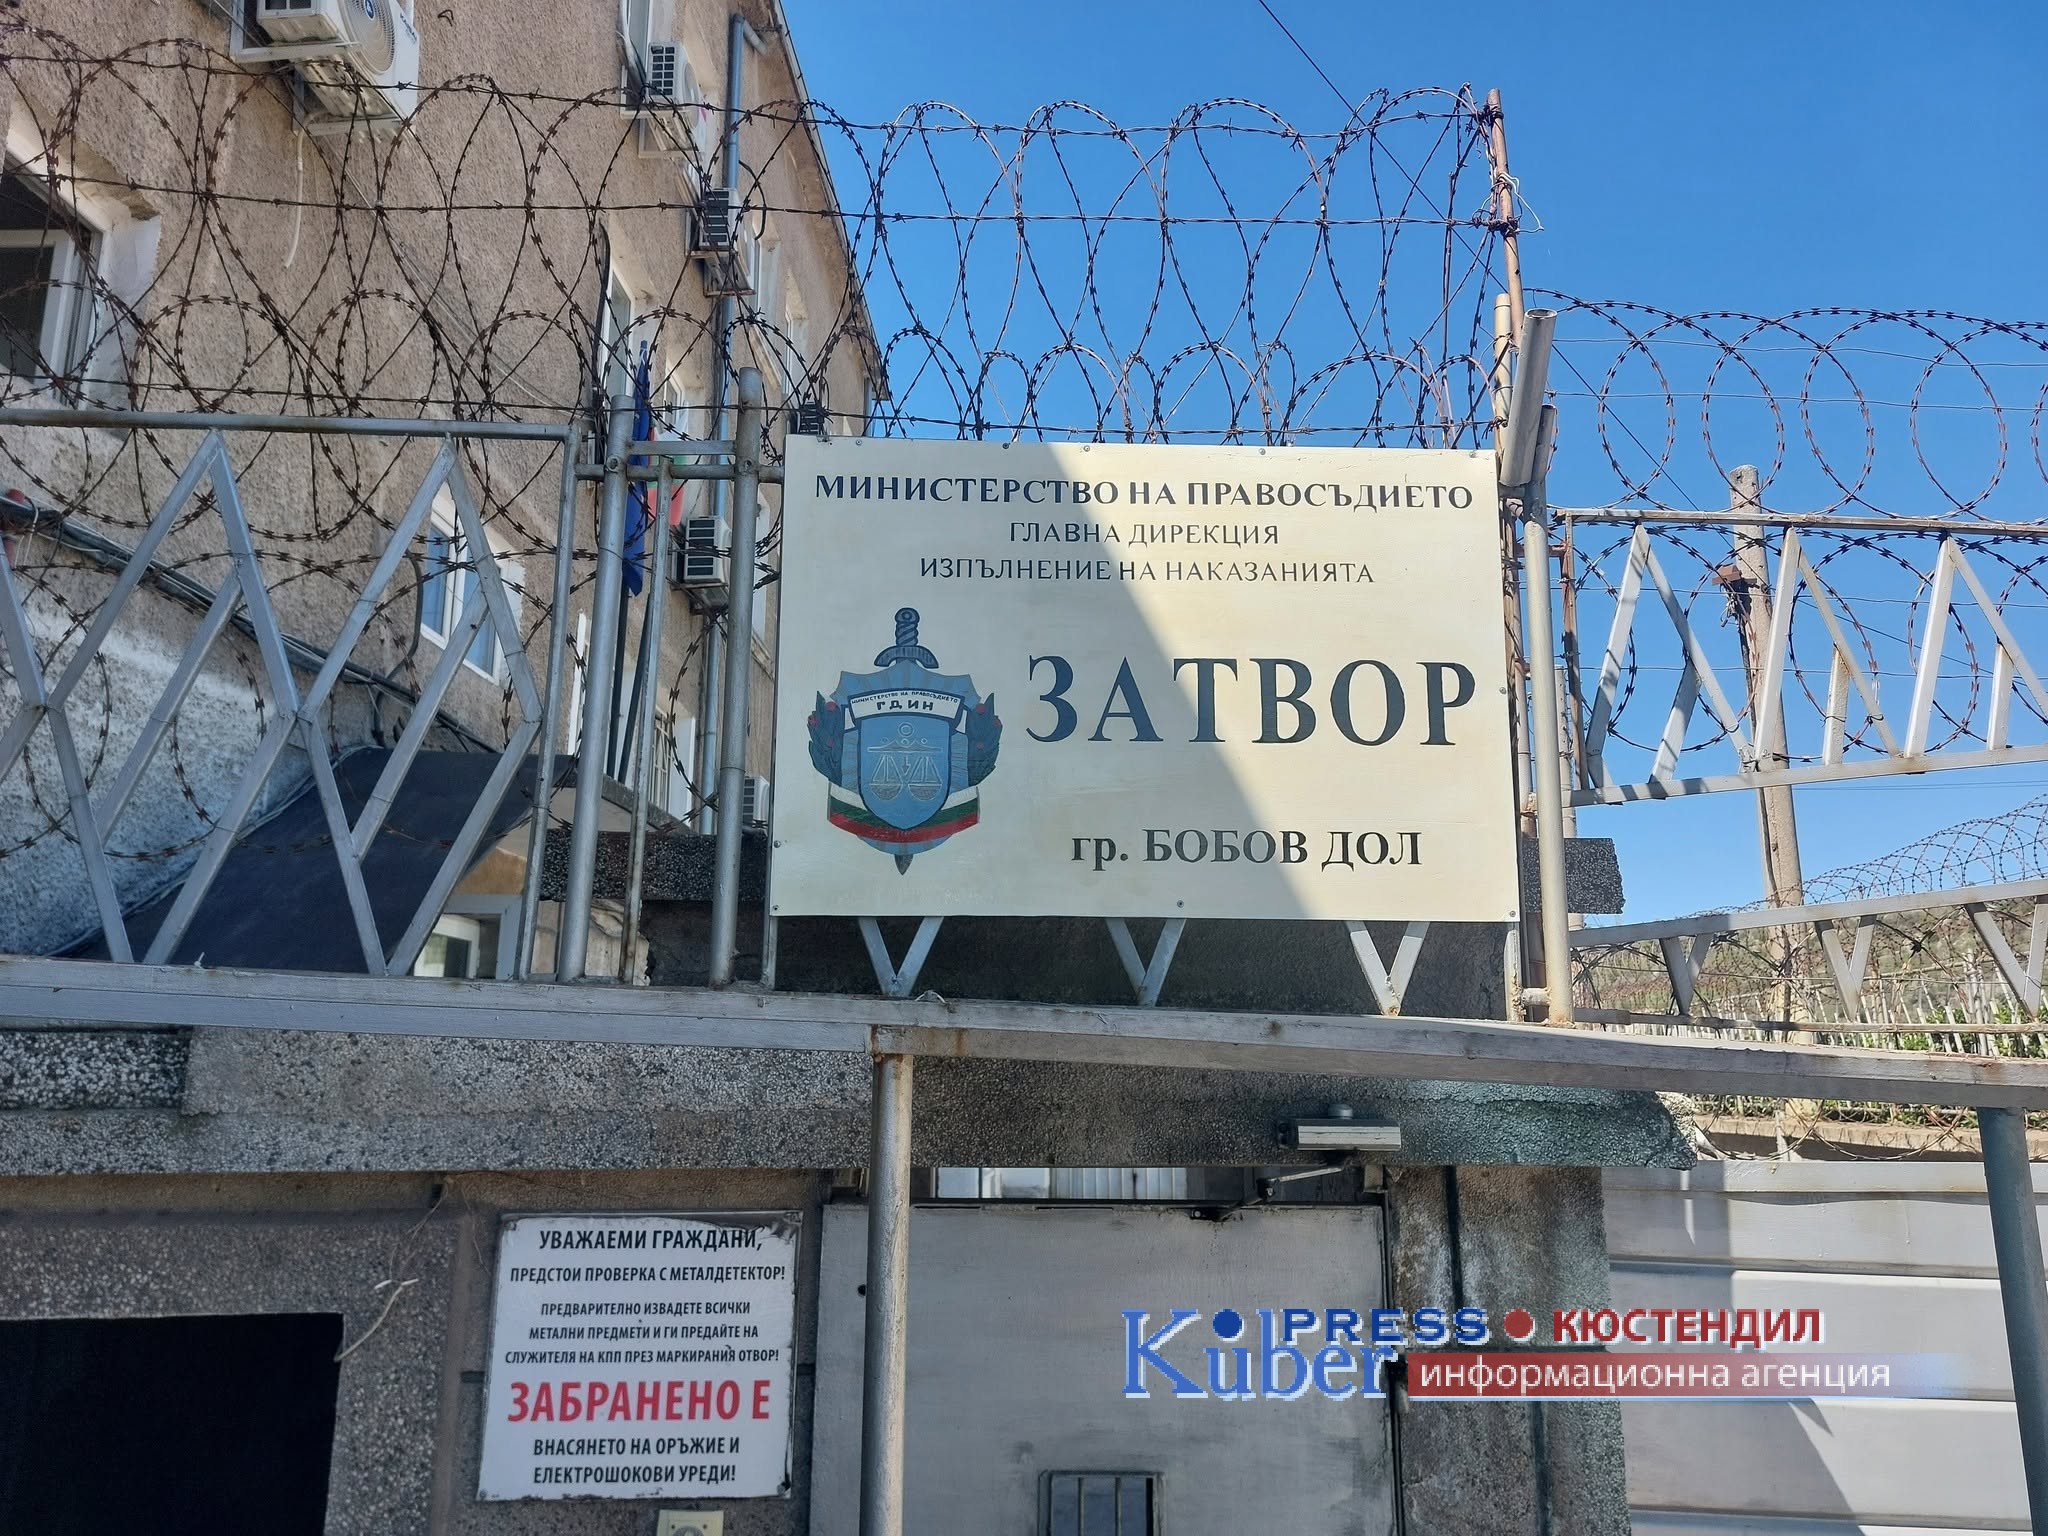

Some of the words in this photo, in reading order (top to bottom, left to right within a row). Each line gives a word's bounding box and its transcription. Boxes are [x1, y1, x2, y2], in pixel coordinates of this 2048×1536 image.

[816, 475, 1118, 504] МИНИСТЕРСТВО
[1130, 482, 1176, 504] НА
[1188, 483, 1472, 513] ПРАВОСЪДИЕТО
[1011, 523, 1120, 543] ГЛАВНА
[1129, 525, 1278, 548] ДИРЕКЦИЯ
[921, 558, 1112, 582] ИЗПЪЛНЕНИЕ
[1120, 561, 1156, 582] НА
[1167, 562, 1374, 582] НАКАЗАНИЯТА
[876, 700, 933, 710] ГДИН
[1026, 655, 1475, 746] ЗАТВОР
[1072, 838, 1128, 871] гр.
[1142, 829, 1308, 863] БОБОВ
[1321, 832, 1422, 872] ДОЛ
[539, 1230, 647, 1249] УВАЖАЕМИ
[652, 1229, 763, 1252] ГРАЖДАНИ,
[510, 1267, 581, 1284] ПРЕДСТОИ
[585, 1267, 656, 1281] ПРОВЕРКА
[659, 1267, 667, 1281] С
[670, 1266, 785, 1283] МЕТАЛДЕТЕКТОР!
[541, 1303, 641, 1317] ПРЕДВАРИТЕЛНО
[644, 1302, 702, 1317] ИЗВАДЕТЕ
[705, 1302, 750, 1314] ВСИЧКИ
[529, 1327, 584, 1339] МЕТАЛНИ
[588, 1327, 650, 1341] ПРЕДМЕТИ
[653, 1326, 661, 1338] И
[664, 1326, 678, 1338] ГИ
[681, 1324, 740, 1341] ПРЕДАЙТЕ
[743, 1325, 758, 1338] НА
[505, 1351, 576, 1363] СЛУЖИТЕЛЯ
[579, 1351, 594, 1363] НА
[598, 1351, 621, 1363] КПП
[625, 1351, 653, 1363] ПРЕЗ
[656, 1349, 735, 1363] МАРКИРАНИЯ
[739, 1349, 779, 1362] ОТВОР!
[508, 1380, 740, 1422] ЗАБРАНЕНО
[752, 1380, 770, 1419] Е
[533, 1438, 626, 1455] ВНАСЯНЕТО
[630, 1438, 651, 1455] НА
[656, 1437, 725, 1454] ОРЪЖИЕ
[730, 1437, 739, 1453] И
[534, 1466, 675, 1483] ЕЛЕКТРОШОКОВИ
[679, 1465, 735, 1485] УРЕДИ!
